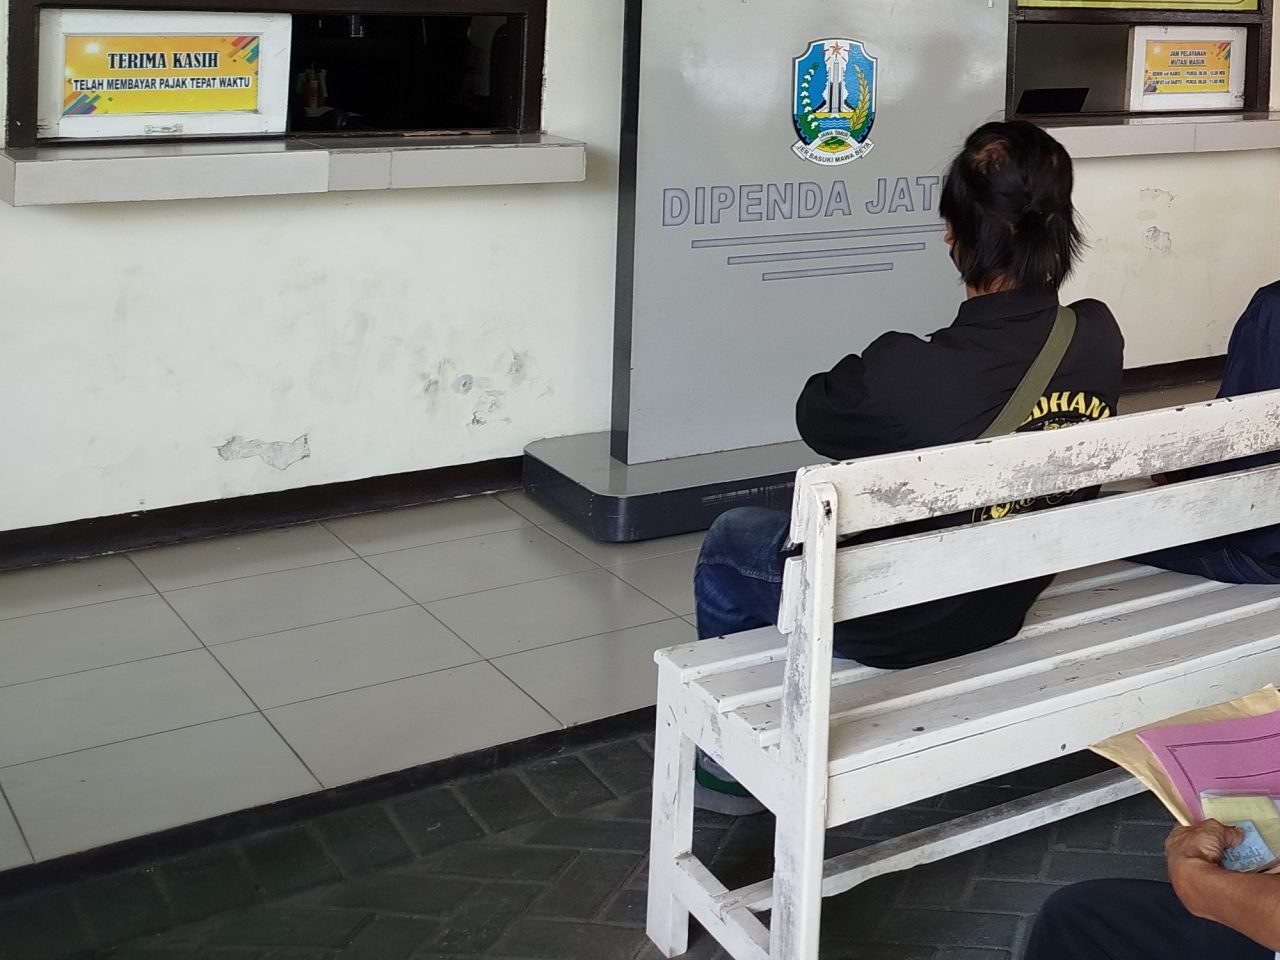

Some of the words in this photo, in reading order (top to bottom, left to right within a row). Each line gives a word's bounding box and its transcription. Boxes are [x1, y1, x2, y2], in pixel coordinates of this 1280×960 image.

[108, 52, 166, 69] TERIMA
[173, 52, 218, 68] KASIH
[73, 79, 104, 91] TELAH
[106, 78, 157, 90] MEMBAYAR
[159, 77, 188, 89] PAJAK
[190, 77, 217, 89] TEPAT
[218, 76, 250, 88] WAKTU
[834, 130, 848, 138] TIMUR
[797, 145, 809, 155] JER
[809, 153, 833, 162] BASUKI
[835, 153, 854, 162] MAWA
[855, 142, 871, 156] BEYA
[662, 180, 852, 227] DIPENDA
